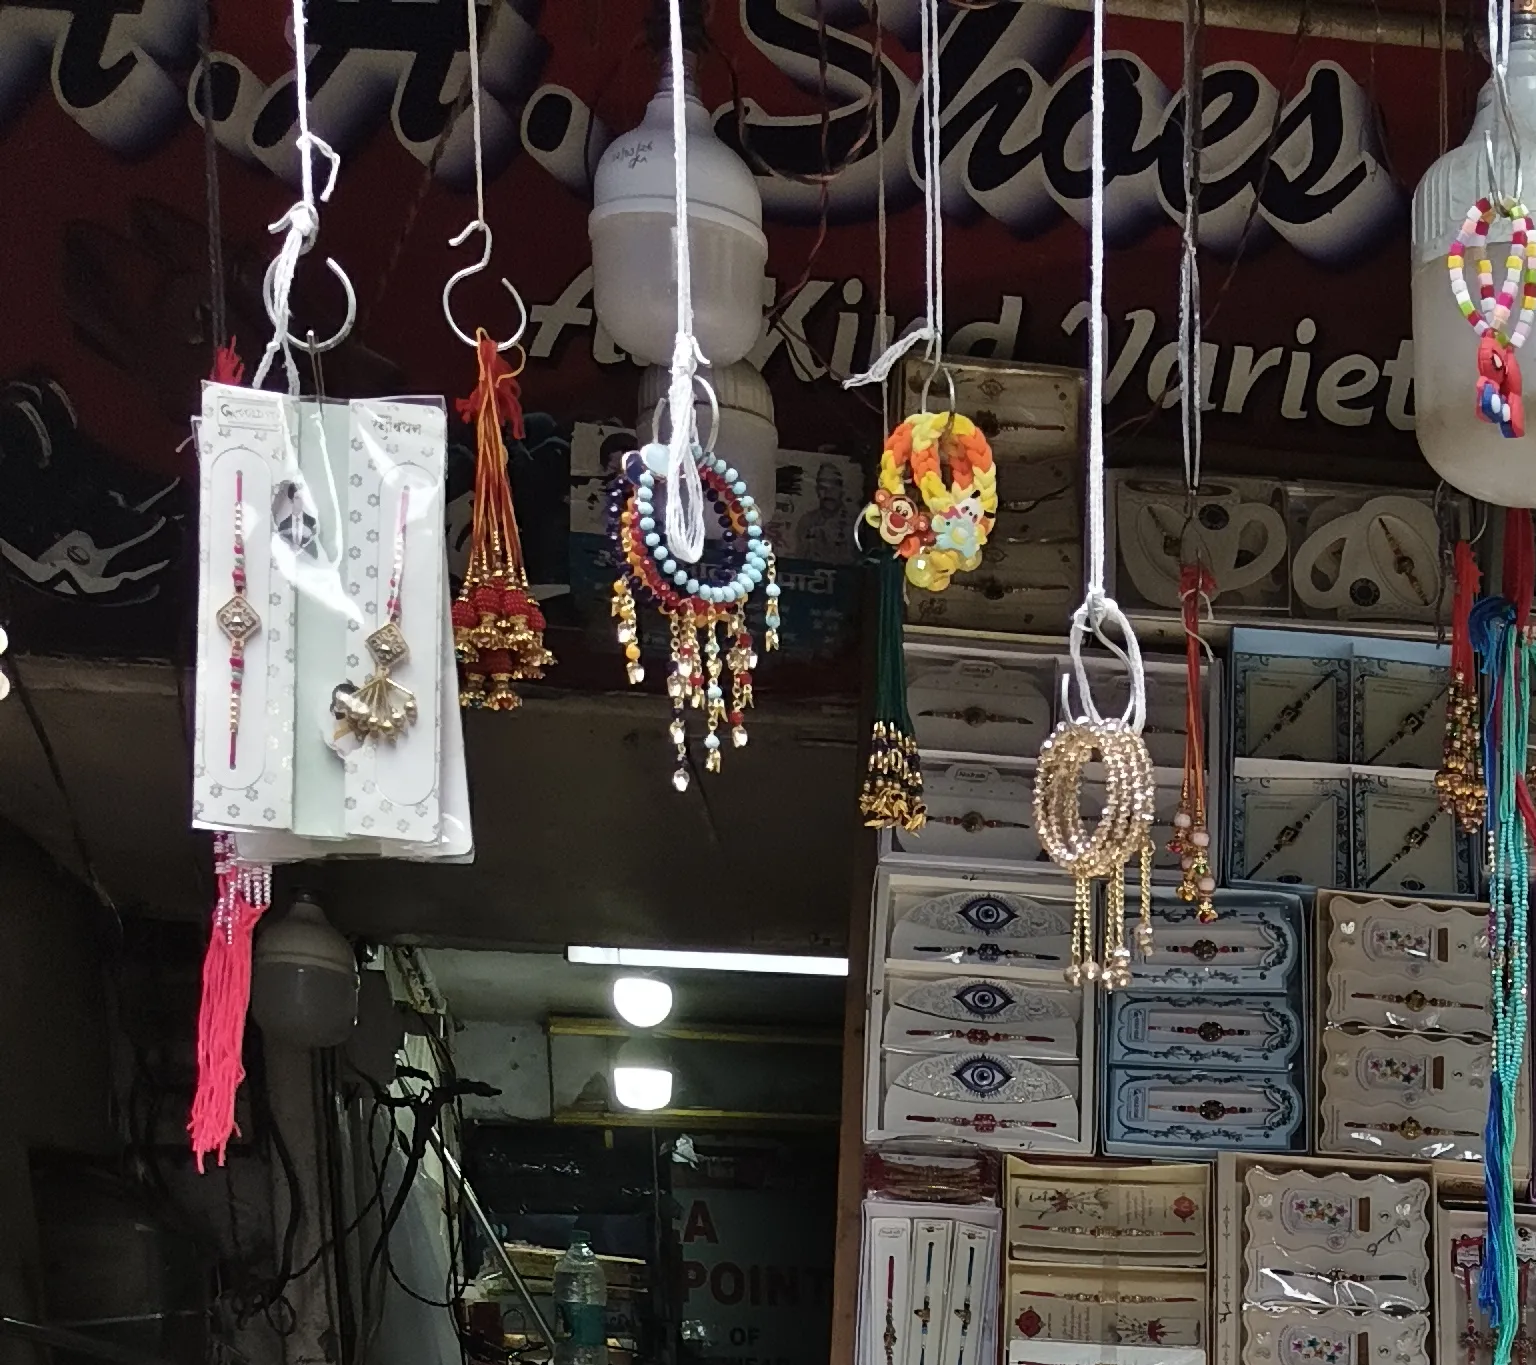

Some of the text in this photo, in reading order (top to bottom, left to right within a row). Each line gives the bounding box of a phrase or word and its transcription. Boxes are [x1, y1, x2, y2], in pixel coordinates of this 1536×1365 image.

[713, 0, 1375, 232] Shoes
[1060, 298, 1415, 432] Variet
[683, 1200, 719, 1243] A
[680, 1262, 833, 1307] POINT
[730, 1327, 760, 1347] OF
